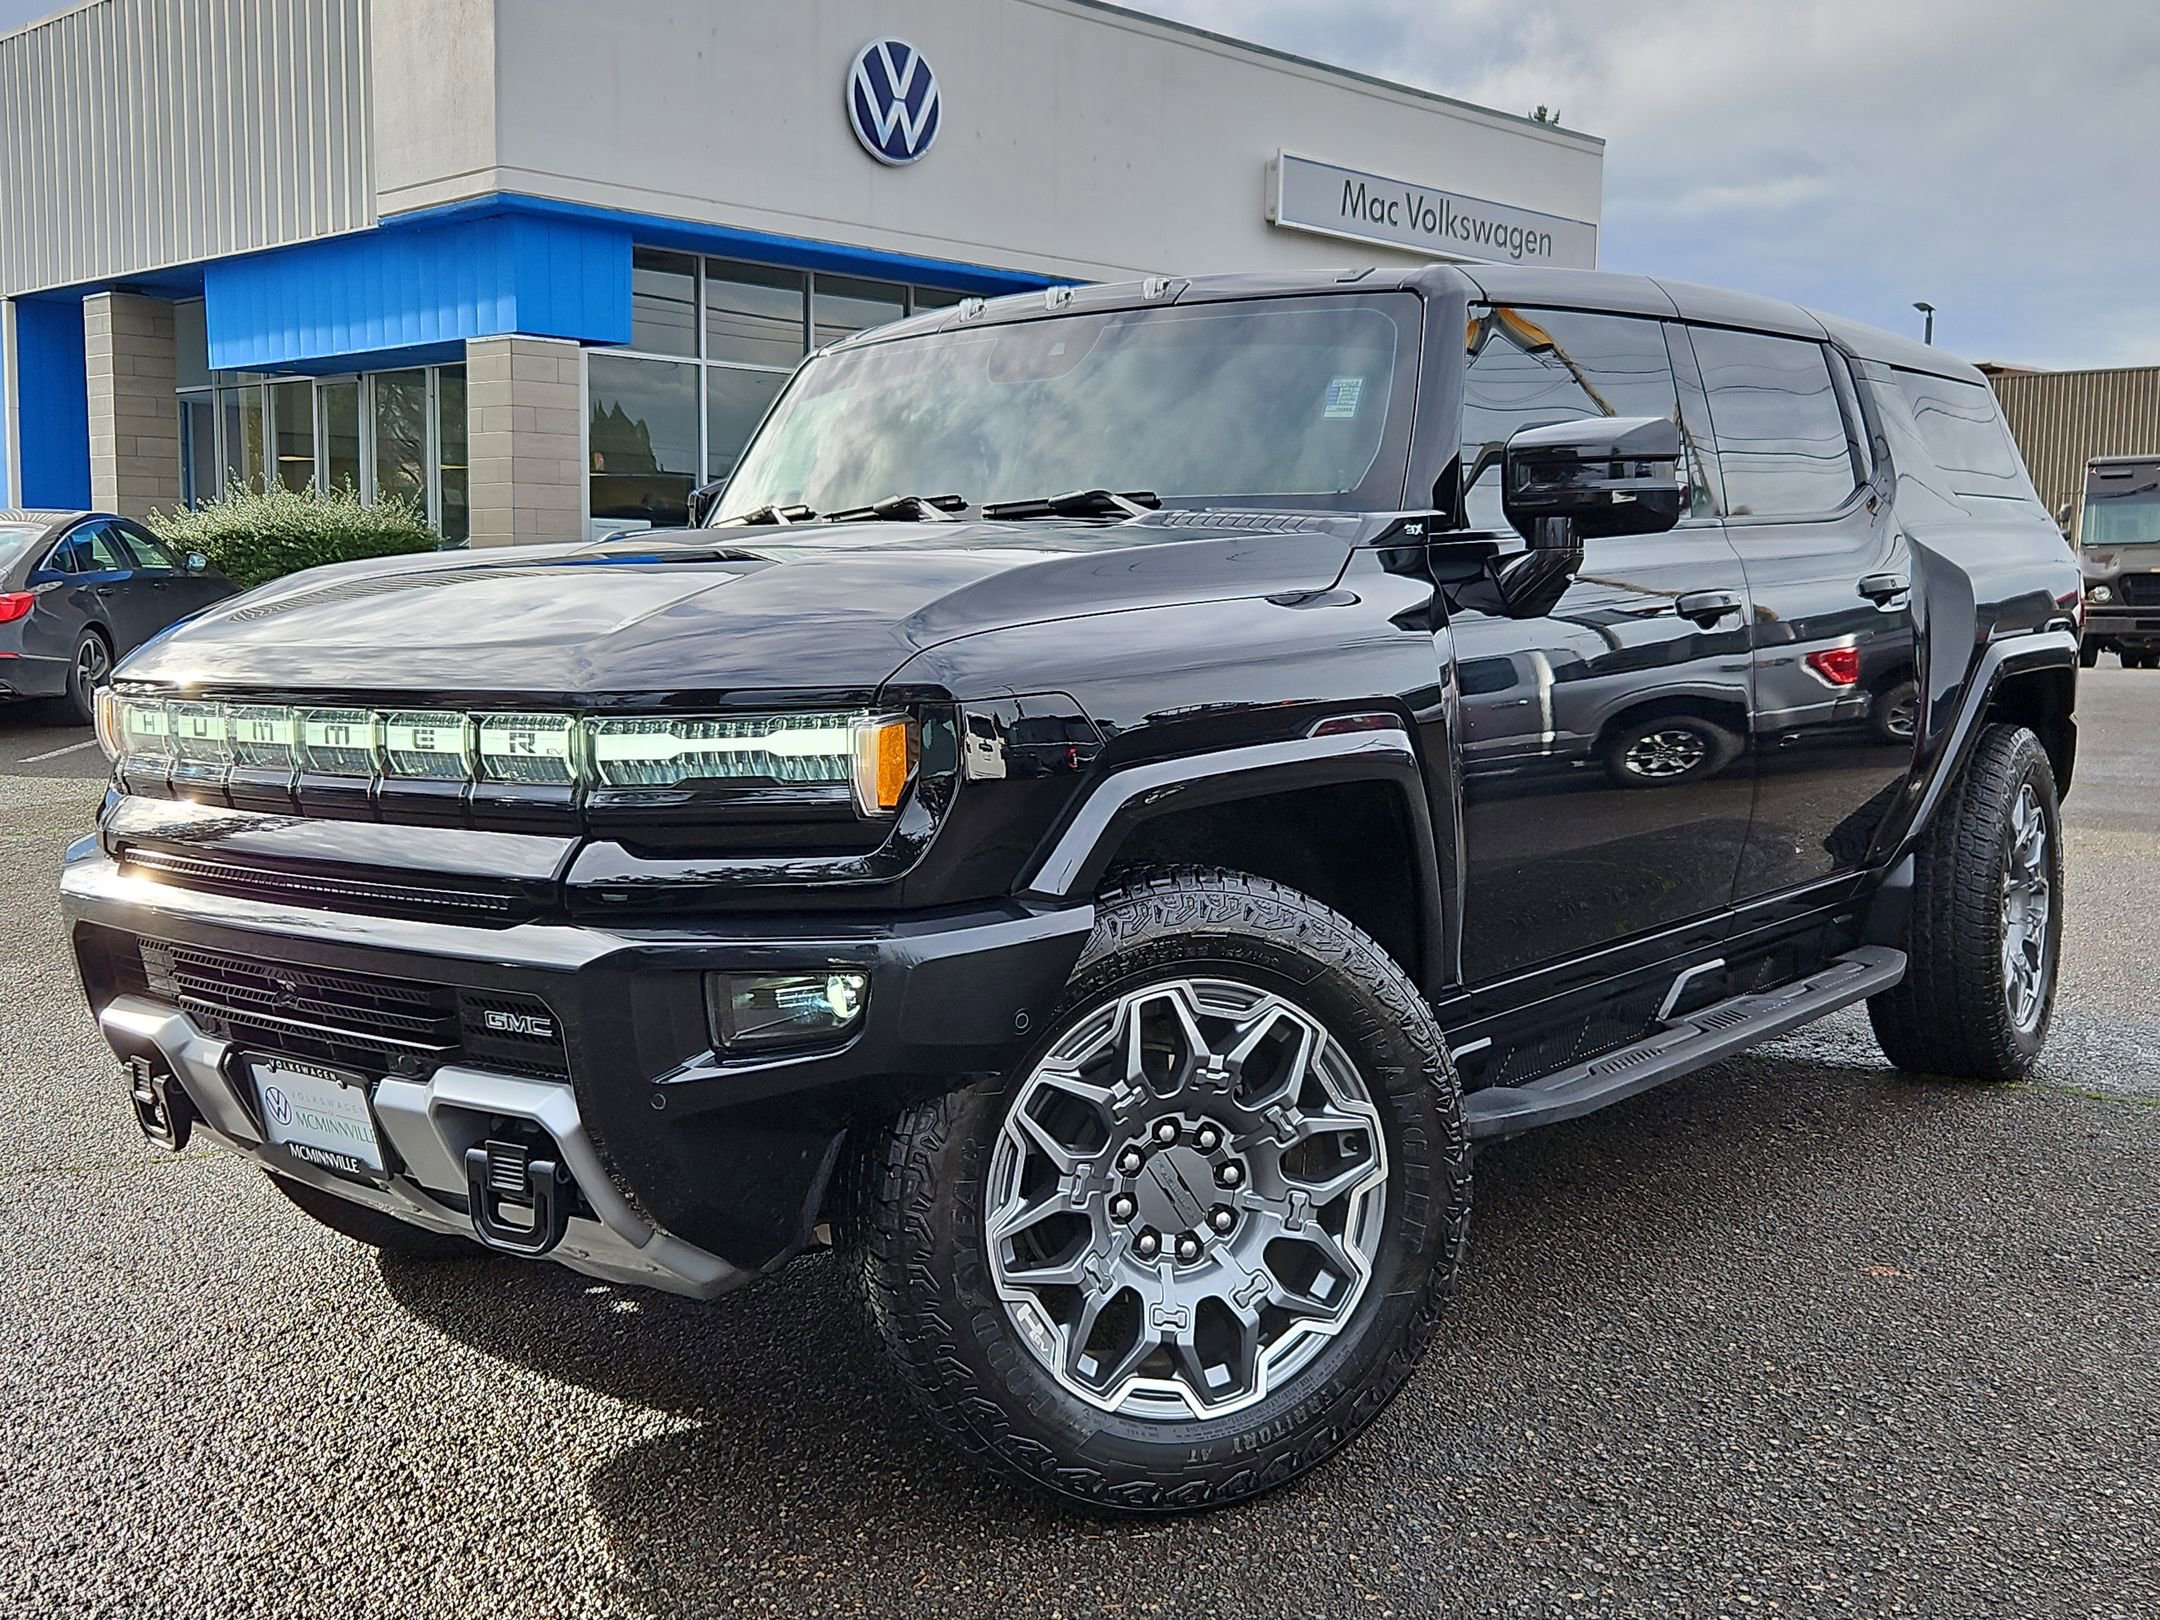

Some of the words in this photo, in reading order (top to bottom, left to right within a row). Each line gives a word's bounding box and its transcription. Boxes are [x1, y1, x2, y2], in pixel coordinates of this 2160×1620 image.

[1340, 179, 1399, 227] Mac
[1404, 191, 1552, 260] Volkswagen
[142, 713, 536, 755] HUMMER
[483, 1010, 553, 1037] GMC
[268, 1058, 338, 1082] VOLKSWAGEN
[288, 1143, 361, 1173] MCMINNVILLE
[1231, 1377, 1347, 1455] TERRITORY
[1186, 1447, 1213, 1463] AT
